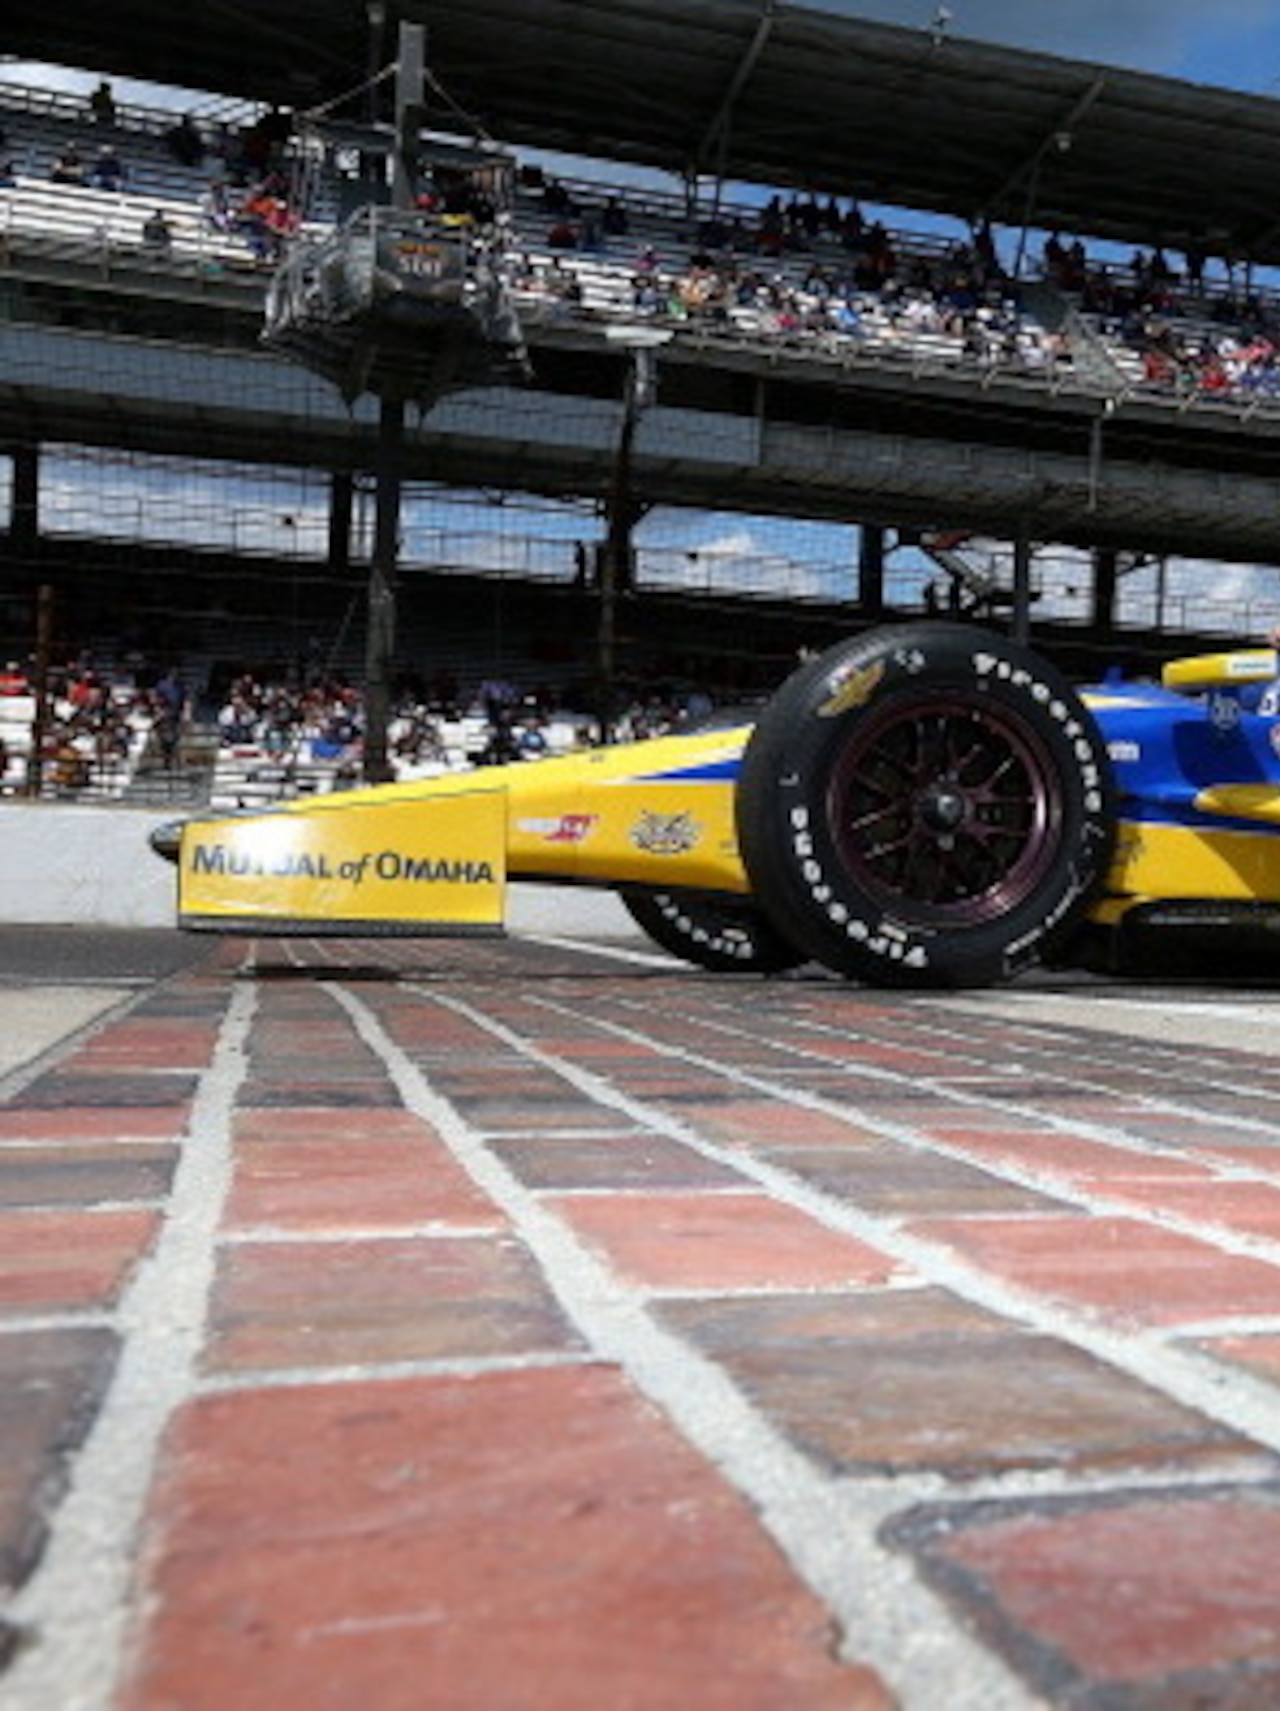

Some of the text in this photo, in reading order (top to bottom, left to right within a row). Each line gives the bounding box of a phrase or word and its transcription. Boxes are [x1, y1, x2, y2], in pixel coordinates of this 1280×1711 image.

[972, 651, 1102, 814] Firestone
[339, 853, 371, 885] of
[376, 851, 495, 883] OMAHA
[791, 806, 929, 969] Firestone
